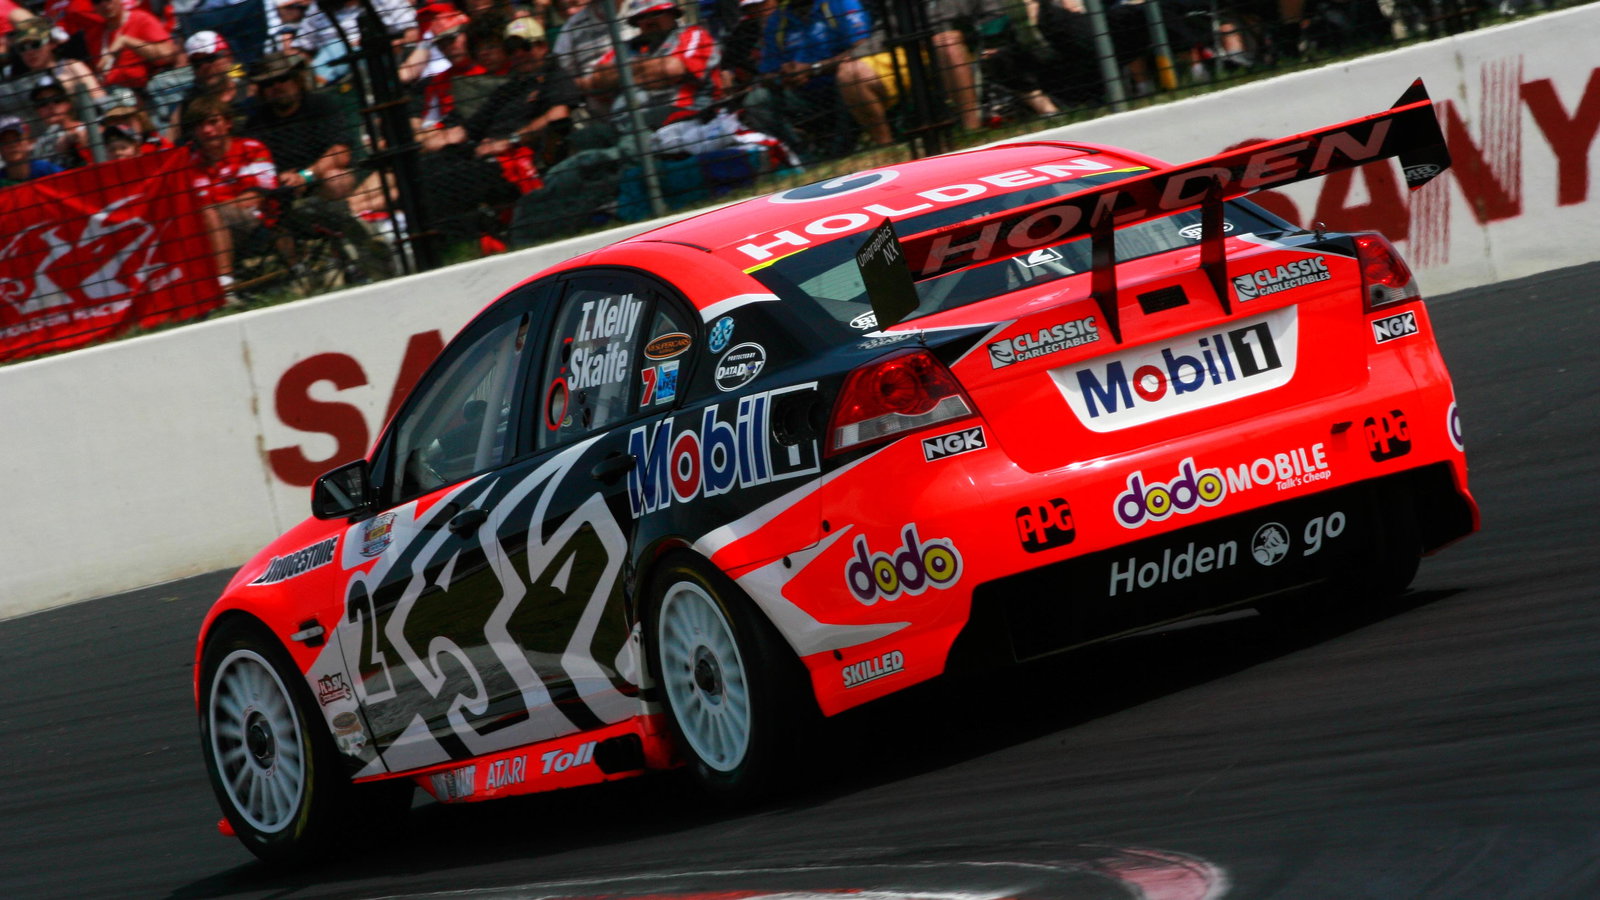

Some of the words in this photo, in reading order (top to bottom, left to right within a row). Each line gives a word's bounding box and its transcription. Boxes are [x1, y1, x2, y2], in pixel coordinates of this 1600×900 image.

[736, 159, 1113, 261] HOLDEN
[921, 119, 1393, 276] HOLDEN
[857, 226, 892, 267] Unigraphics
[882, 239, 899, 265] NX
[1254, 256, 1328, 287] CLASSIC
[1259, 271, 1331, 297] CARLECTABLES
[1012, 316, 1098, 352] CLASSIC
[1017, 333, 1100, 362] CARLECTABLES
[1373, 313, 1416, 342] NGK
[568, 343, 628, 392] Skaife
[640, 367, 657, 407] 7
[1076, 333, 1236, 419] Mobil
[1242, 329, 1269, 372] 1
[924, 429, 983, 459] NGK
[1364, 410, 1411, 454] PPG
[627, 391, 770, 519] Mobil
[1115, 458, 1225, 527] dodo
[1226, 443, 1328, 494] MOBILE
[1276, 477, 1302, 491] Talk's
[1303, 470, 1331, 483] Cheap
[1015, 499, 1075, 545] PPG
[847, 525, 961, 603] dodo
[1109, 540, 1238, 597] Holden
[1303, 511, 1346, 556] go
[346, 576, 394, 700] 2
[842, 651, 904, 687] SKILLED
[486, 755, 527, 790] ATARI
[541, 740, 598, 775] Toll
